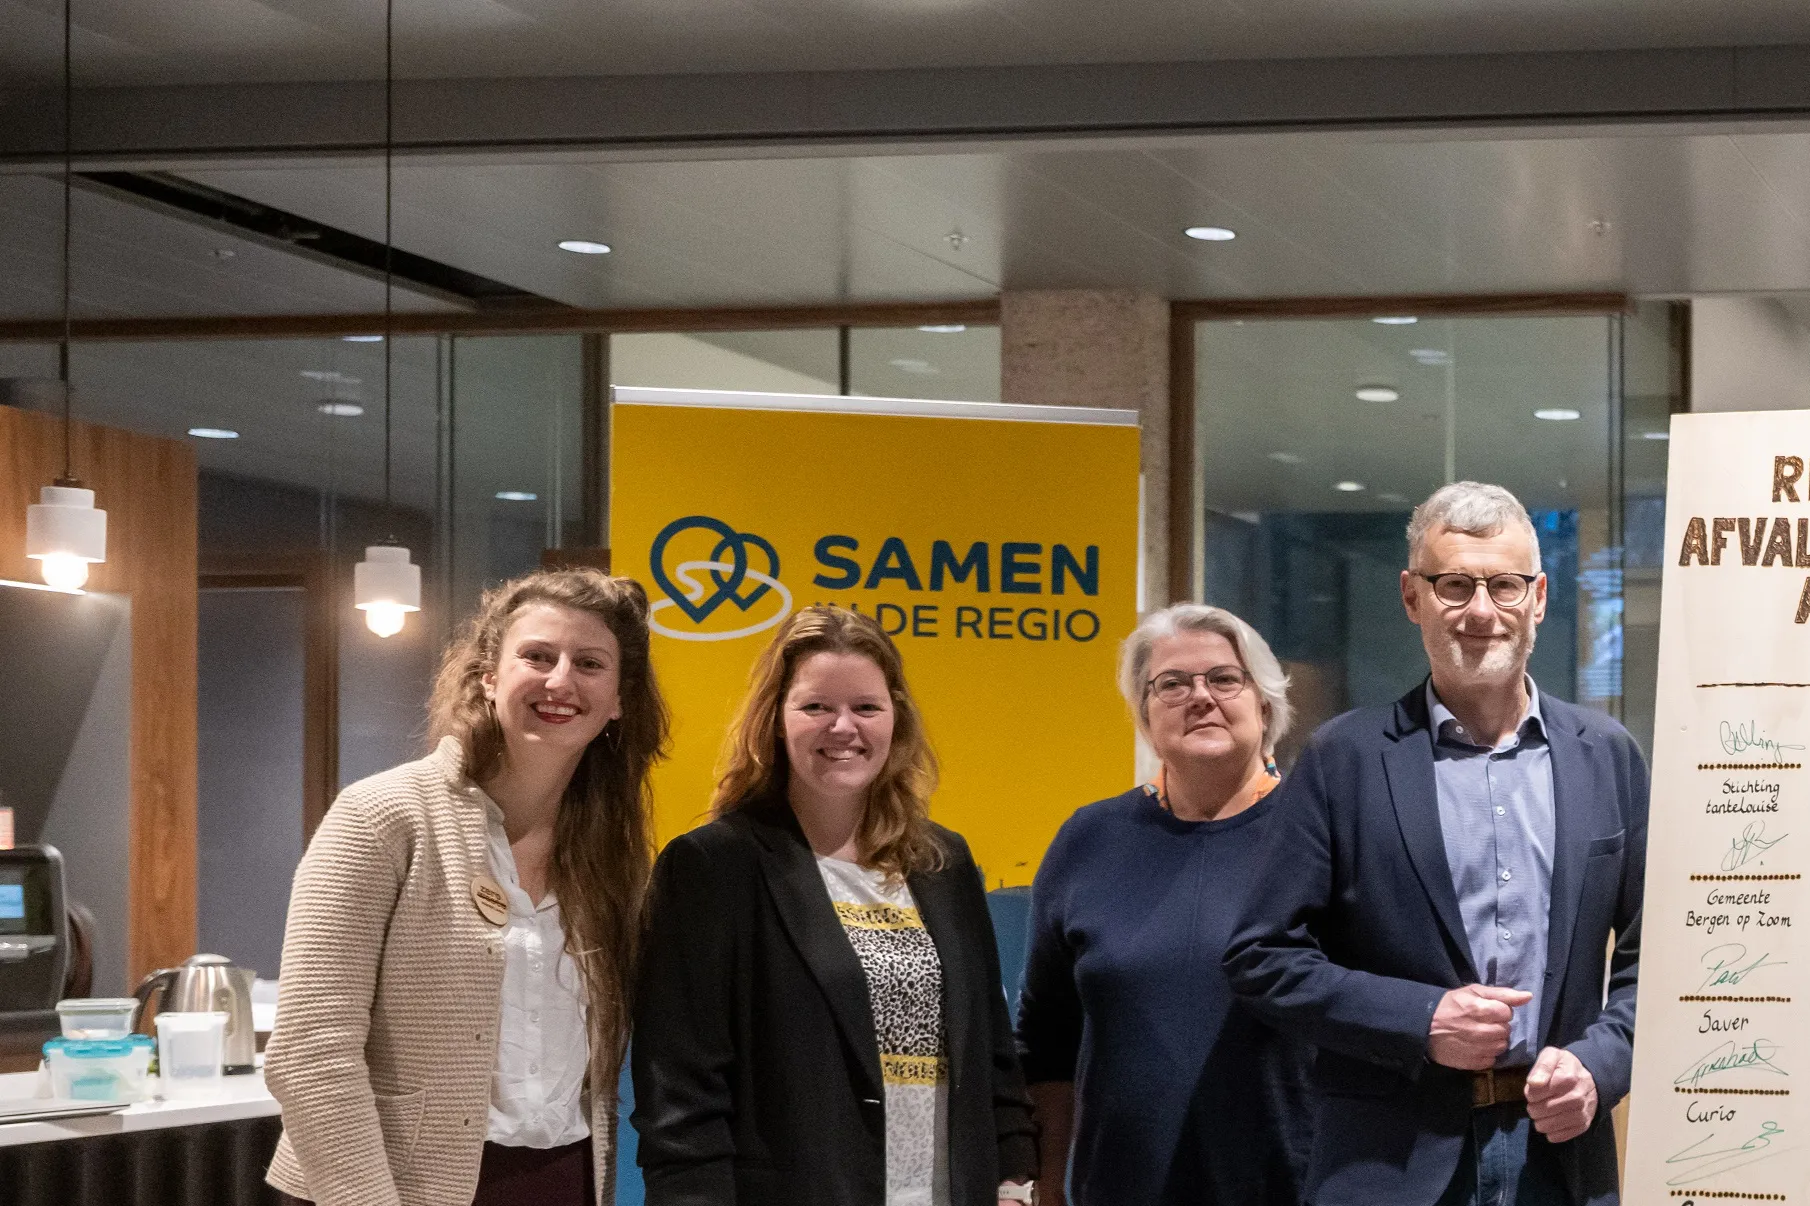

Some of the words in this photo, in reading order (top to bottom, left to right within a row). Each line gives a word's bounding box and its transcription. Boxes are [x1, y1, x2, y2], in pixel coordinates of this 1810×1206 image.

[812, 535, 1100, 596] SAMEN
[876, 604, 939, 638] DE
[956, 606, 1100, 642] REGIO
[1722, 778, 1780, 803] Stichting
[1707, 889, 1771, 905] Gemeente
[1686, 911, 1730, 934] Bergen
[1737, 913, 1750, 932] op
[1756, 911, 1792, 928] Zoom
[1699, 1009, 1749, 1033] Saver
[1686, 1101, 1736, 1123] Curio
